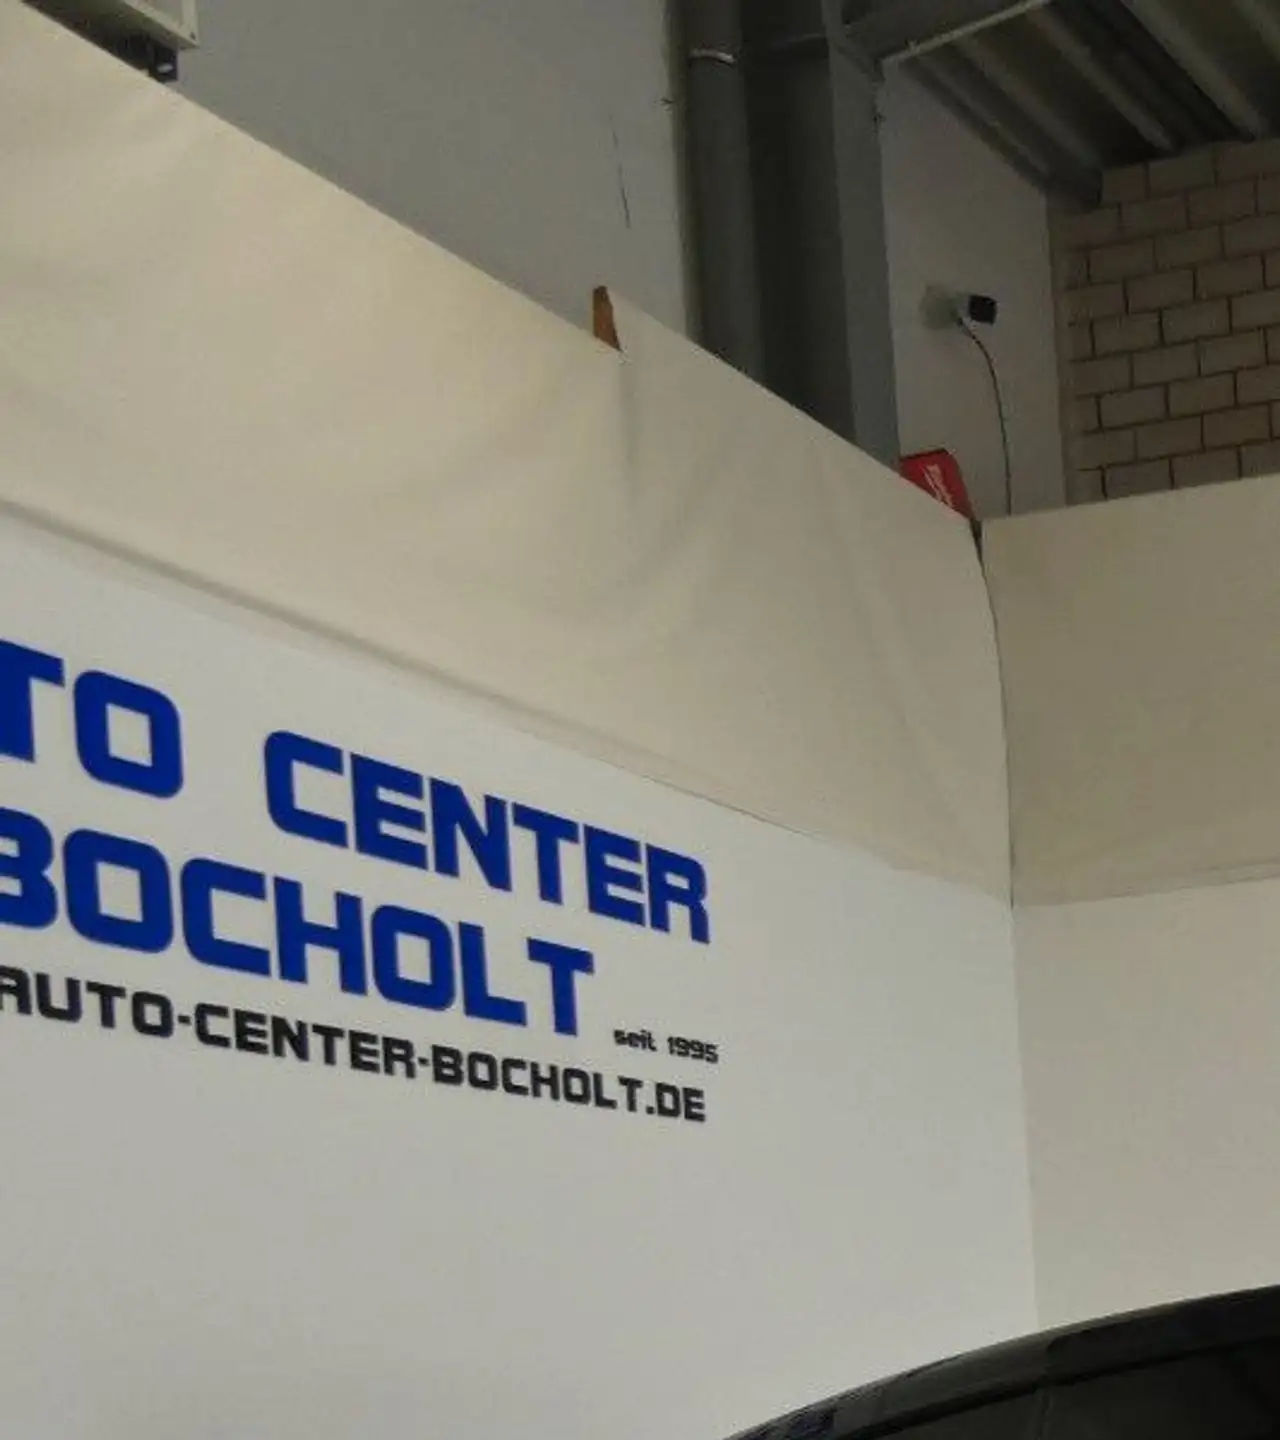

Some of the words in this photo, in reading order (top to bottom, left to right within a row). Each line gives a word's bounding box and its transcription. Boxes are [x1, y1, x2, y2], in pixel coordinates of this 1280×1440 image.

[0, 806, 593, 1036] BOCHOLT
[263, 730, 710, 944] CENTER
[613, 1028, 658, 1053] seit
[667, 1035, 719, 1064] 1995
